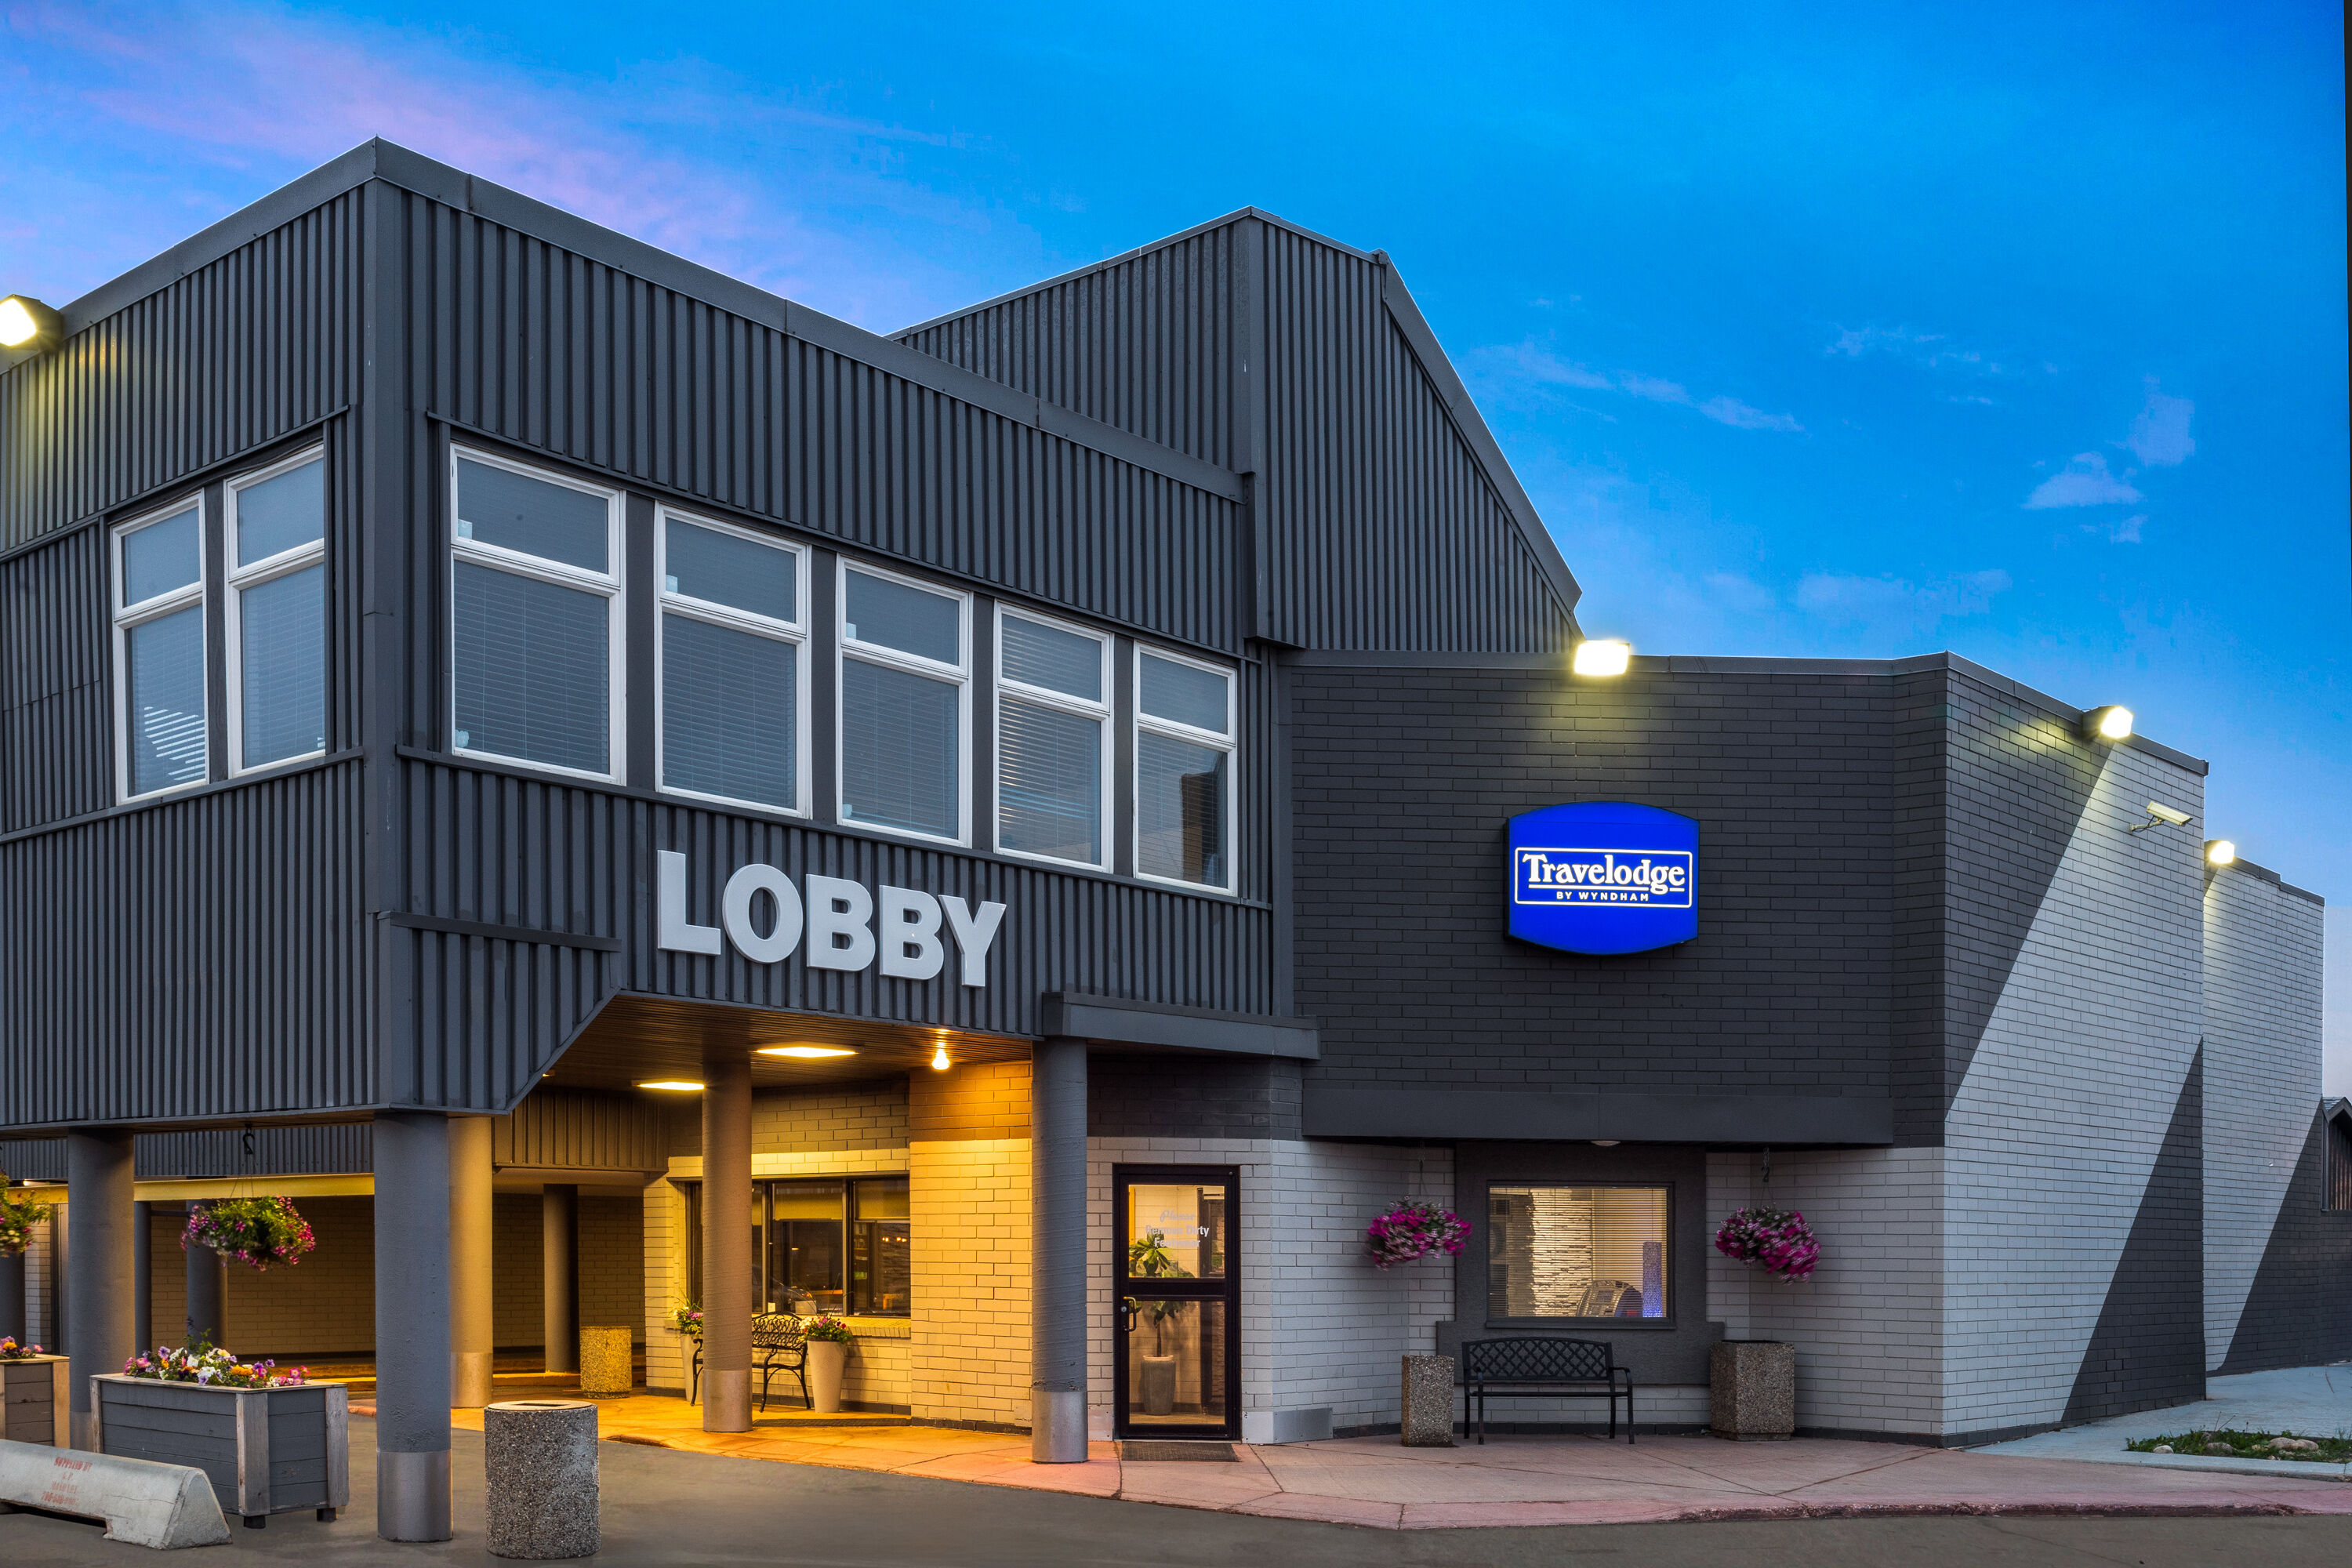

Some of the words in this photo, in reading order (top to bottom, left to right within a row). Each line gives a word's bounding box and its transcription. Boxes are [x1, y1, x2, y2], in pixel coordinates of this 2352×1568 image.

[1522, 853, 1685, 895] Travelodge
[1578, 892, 1649, 901] WYNDHAM
[657, 850, 1007, 988] LOBBY
[1145, 1225, 1183, 1235] Remove
[1186, 1225, 1210, 1237] Dirty
[1154, 1237, 1200, 1247] Footwear
